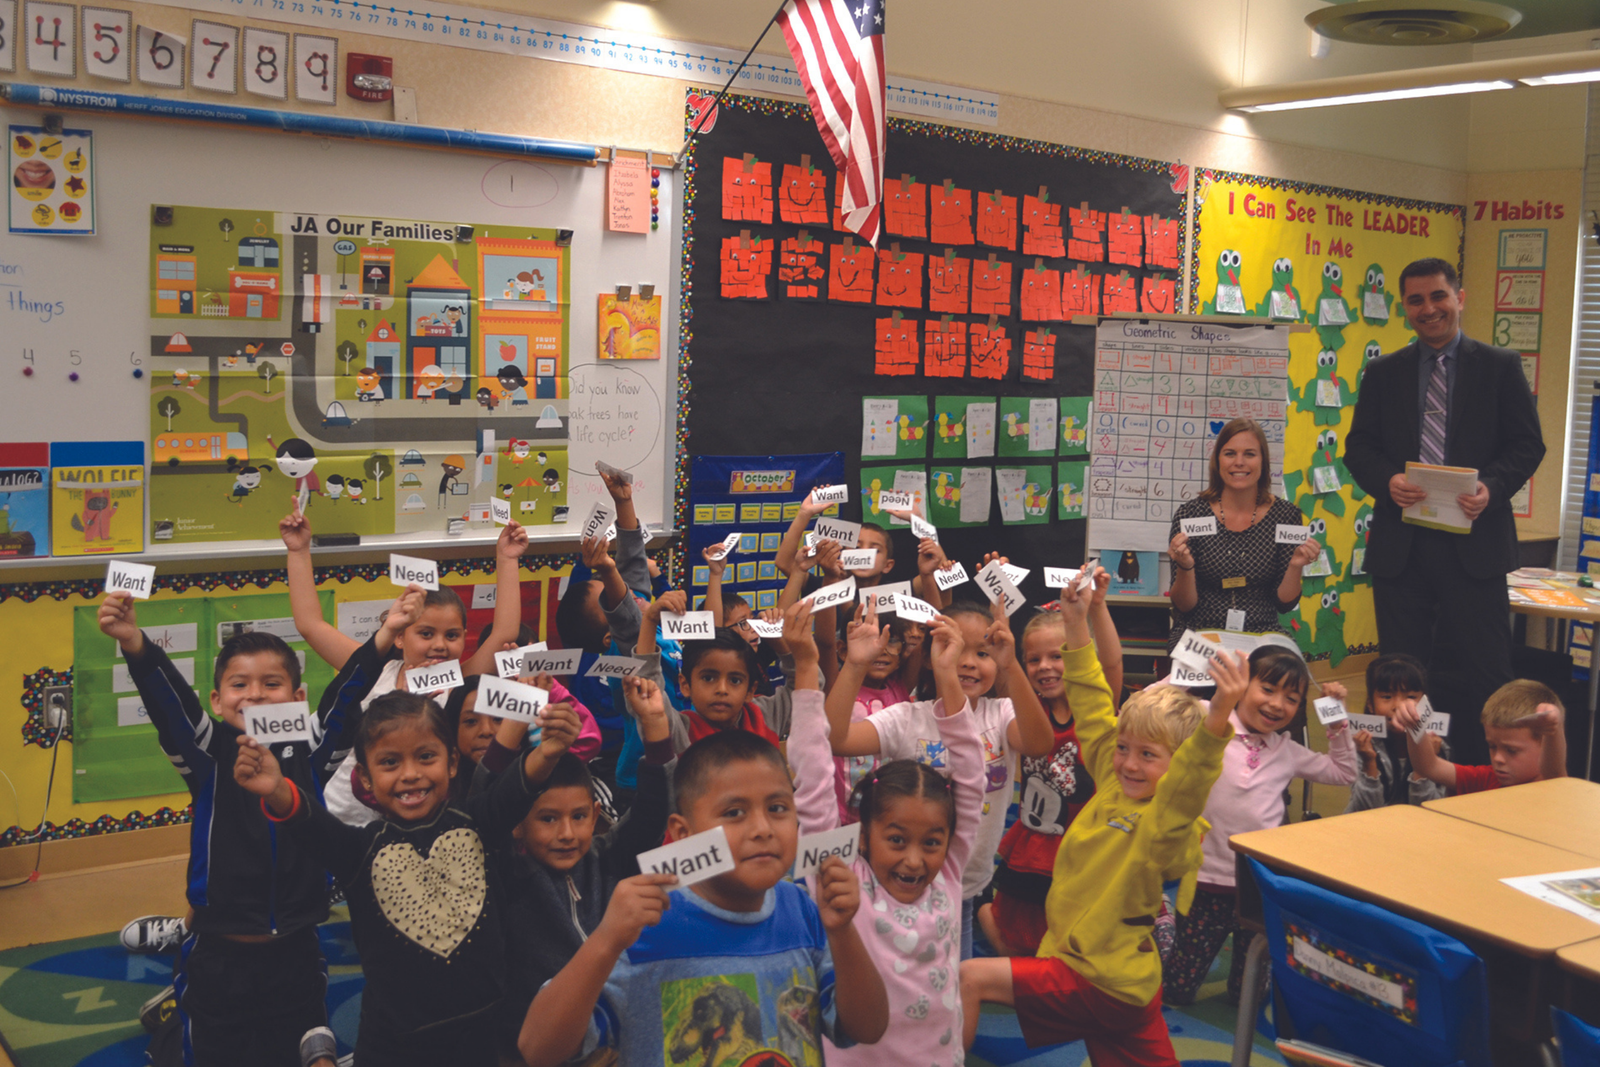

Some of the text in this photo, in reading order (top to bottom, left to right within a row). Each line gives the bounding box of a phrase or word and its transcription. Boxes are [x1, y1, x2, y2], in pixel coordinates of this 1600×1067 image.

[36, 16, 67, 61] 4
[94, 23, 122, 64] 5
[149, 31, 174, 70] 6
[202, 38, 230, 78] 7
[272, 0, 284, 10] 72
[292, 3, 304, 13] 73
[311, 5, 323, 15] 74
[331, 8, 342, 18] 75
[350, 11, 361, 21] 76
[368, 13, 380, 24] 77
[386, 16, 398, 27] 78
[404, 19, 416, 29] 79
[422, 22, 434, 32] 80
[442, 25, 451, 34] 81
[459, 27, 470, 37] 82
[476, 30, 487, 39] 83
[493, 32, 504, 42] 84
[510, 35, 520, 44] 85
[526, 38, 537, 47] 86
[543, 40, 553, 50] 87
[559, 42, 570, 52] 88
[575, 45, 586, 54] 89
[591, 47, 601, 57] 90
[608, 50, 617, 58] 91
[624, 52, 633, 61] 92
[639, 54, 648, 64] 93
[654, 56, 663, 66] 94
[668, 59, 678, 68] 95
[683, 61, 692, 71] 96
[697, 64, 706, 73] 97
[712, 66, 721, 75] 98
[738, 70, 750, 80] 100
[754, 72, 765, 81] 101
[768, 74, 779, 83] 102
[781, 76, 792, 85] 103
[896, 94, 906, 103] 112
[920, 98, 929, 106] 114
[932, 100, 942, 109] 115
[943, 102, 953, 110] 116
[955, 104, 964, 112] 117
[966, 106, 975, 114] 118
[976, 108, 986, 116] 119
[988, 110, 997, 118] 120
[255, 45, 278, 83] 8
[305, 52, 329, 91] 9
[362, 90, 383, 99] FIRE
[59, 92, 247, 120] NYSTROM HERFF JONES EDUCATION DIVISION
[1228, 191, 1430, 238] I Can See The LEADER
[1474, 200, 1564, 220] 7 Habits
[291, 216, 454, 241] JA Our Families
[1304, 232, 1354, 258] In Me
[1498, 276, 1513, 306] 2
[7, 290, 64, 322] things
[1123, 322, 1231, 346] Geometric Shapes
[1496, 318, 1511, 347] 3
[24, 349, 34, 365] 4
[70, 350, 82, 366] 5
[130, 352, 142, 366] 6
[1161, 353, 1172, 372] 4
[1187, 356, 1196, 370] 4
[1160, 375, 1172, 394] 3
[1184, 378, 1196, 394] 3
[589, 384, 608, 404] you
[588, 406, 610, 420] trees
[618, 405, 639, 420] have
[1184, 400, 1194, 414] 4
[576, 425, 593, 444] life
[1096, 426, 1116, 434] circle
[1154, 440, 1166, 456] 4
[1183, 441, 1195, 458] 4
[1154, 462, 1164, 476] 4
[1182, 462, 1192, 480] 4
[744, 474, 784, 484] October
[69, 490, 138, 500] THE BUNNY
[816, 490, 844, 501] Want
[1154, 482, 1164, 496] 6
[1181, 484, 1192, 500] 6
[881, 494, 910, 506] Need
[492, 504, 508, 520] Need
[817, 524, 854, 542] Want
[1184, 522, 1212, 534] Want
[1278, 530, 1308, 542] Need
[843, 555, 871, 566] Want
[112, 571, 146, 592] Want
[394, 564, 434, 584] Need
[938, 570, 965, 586] Need
[812, 586, 850, 608] eed
[352, 616, 357, 624] I
[667, 620, 709, 634] Want
[354, 630, 370, 638] and
[528, 658, 573, 672] Want
[594, 662, 636, 676] Need
[412, 669, 456, 690] Want
[486, 688, 540, 718] Want
[1319, 704, 1344, 719] Want
[252, 714, 306, 736] Need
[1350, 720, 1383, 733] Need
[652, 844, 722, 876] Want
[803, 838, 854, 868] Need
